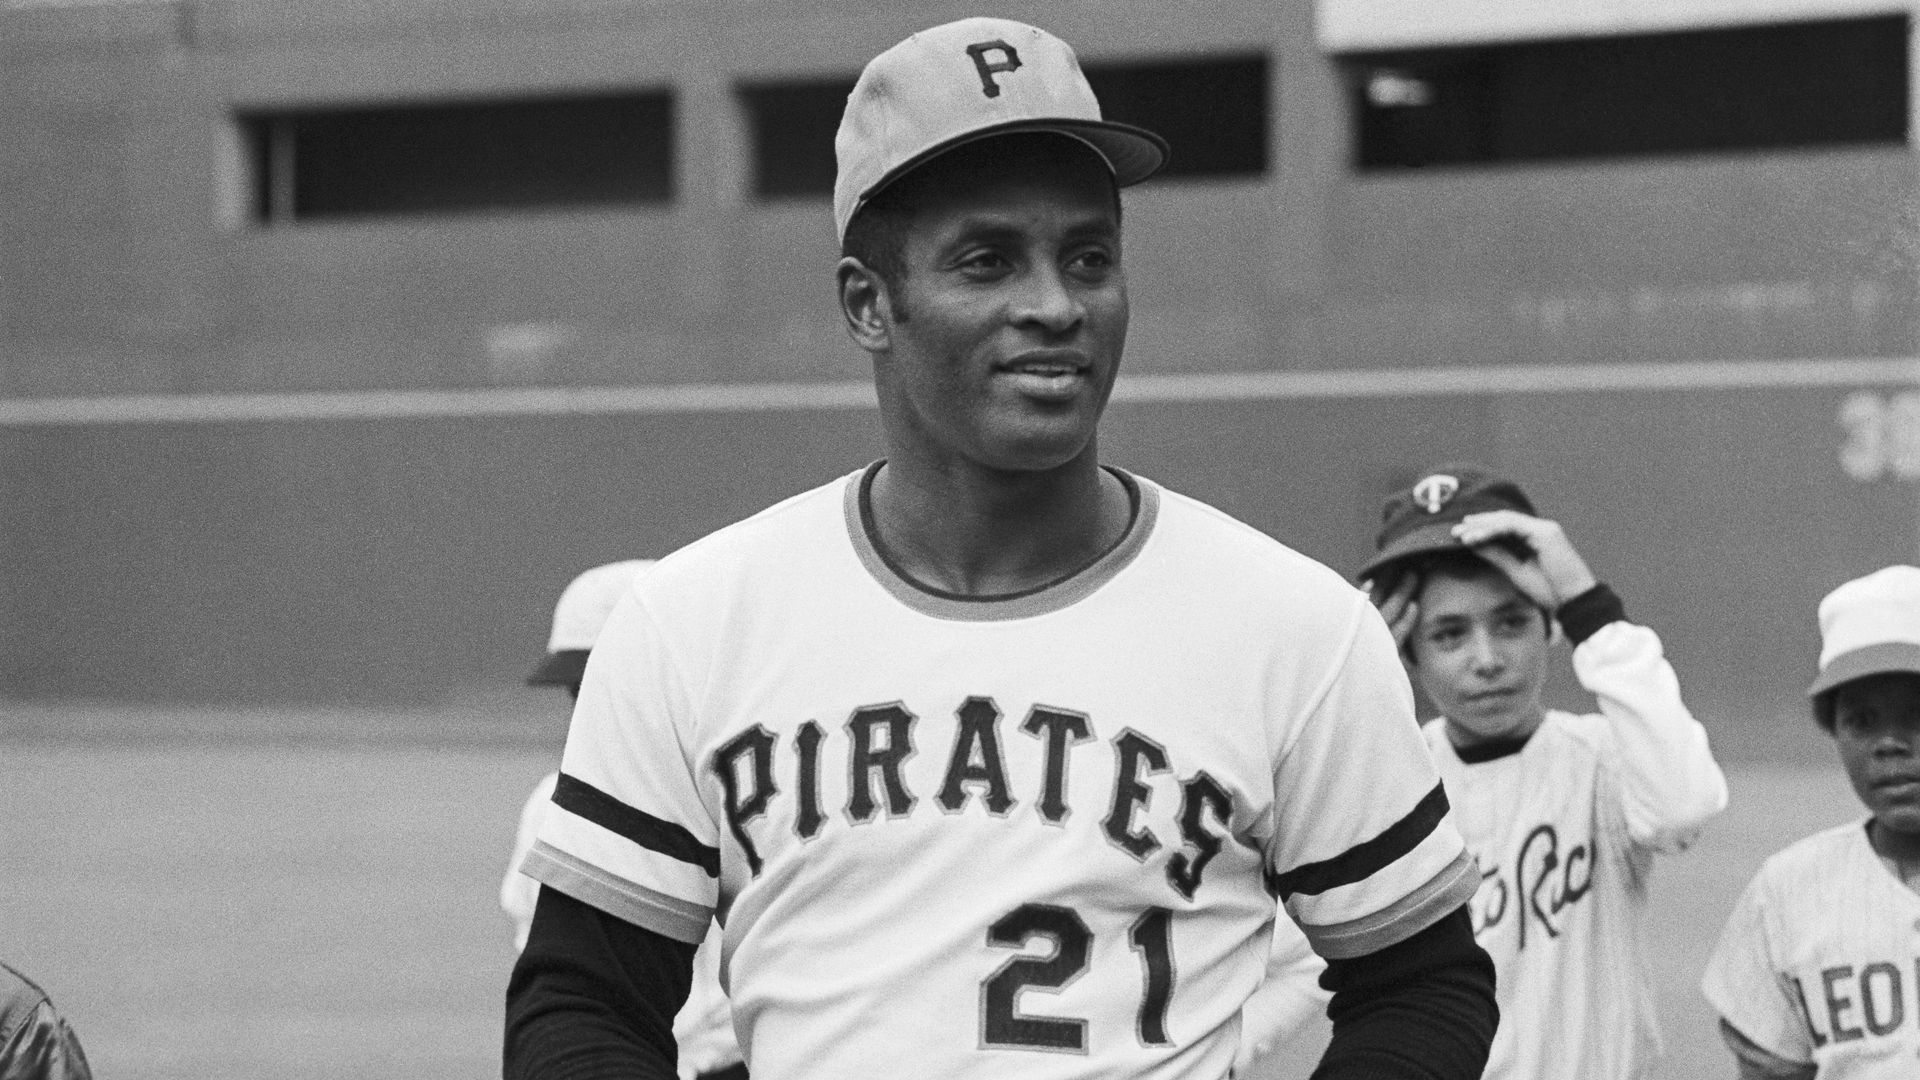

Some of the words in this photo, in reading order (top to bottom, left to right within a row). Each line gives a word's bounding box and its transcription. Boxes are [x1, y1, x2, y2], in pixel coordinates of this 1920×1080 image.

[966, 39, 1023, 98] P
[712, 696, 1234, 902] PIRATES
[977, 903, 1177, 1055] 21
[1783, 957, 1920, 1048] LEO
